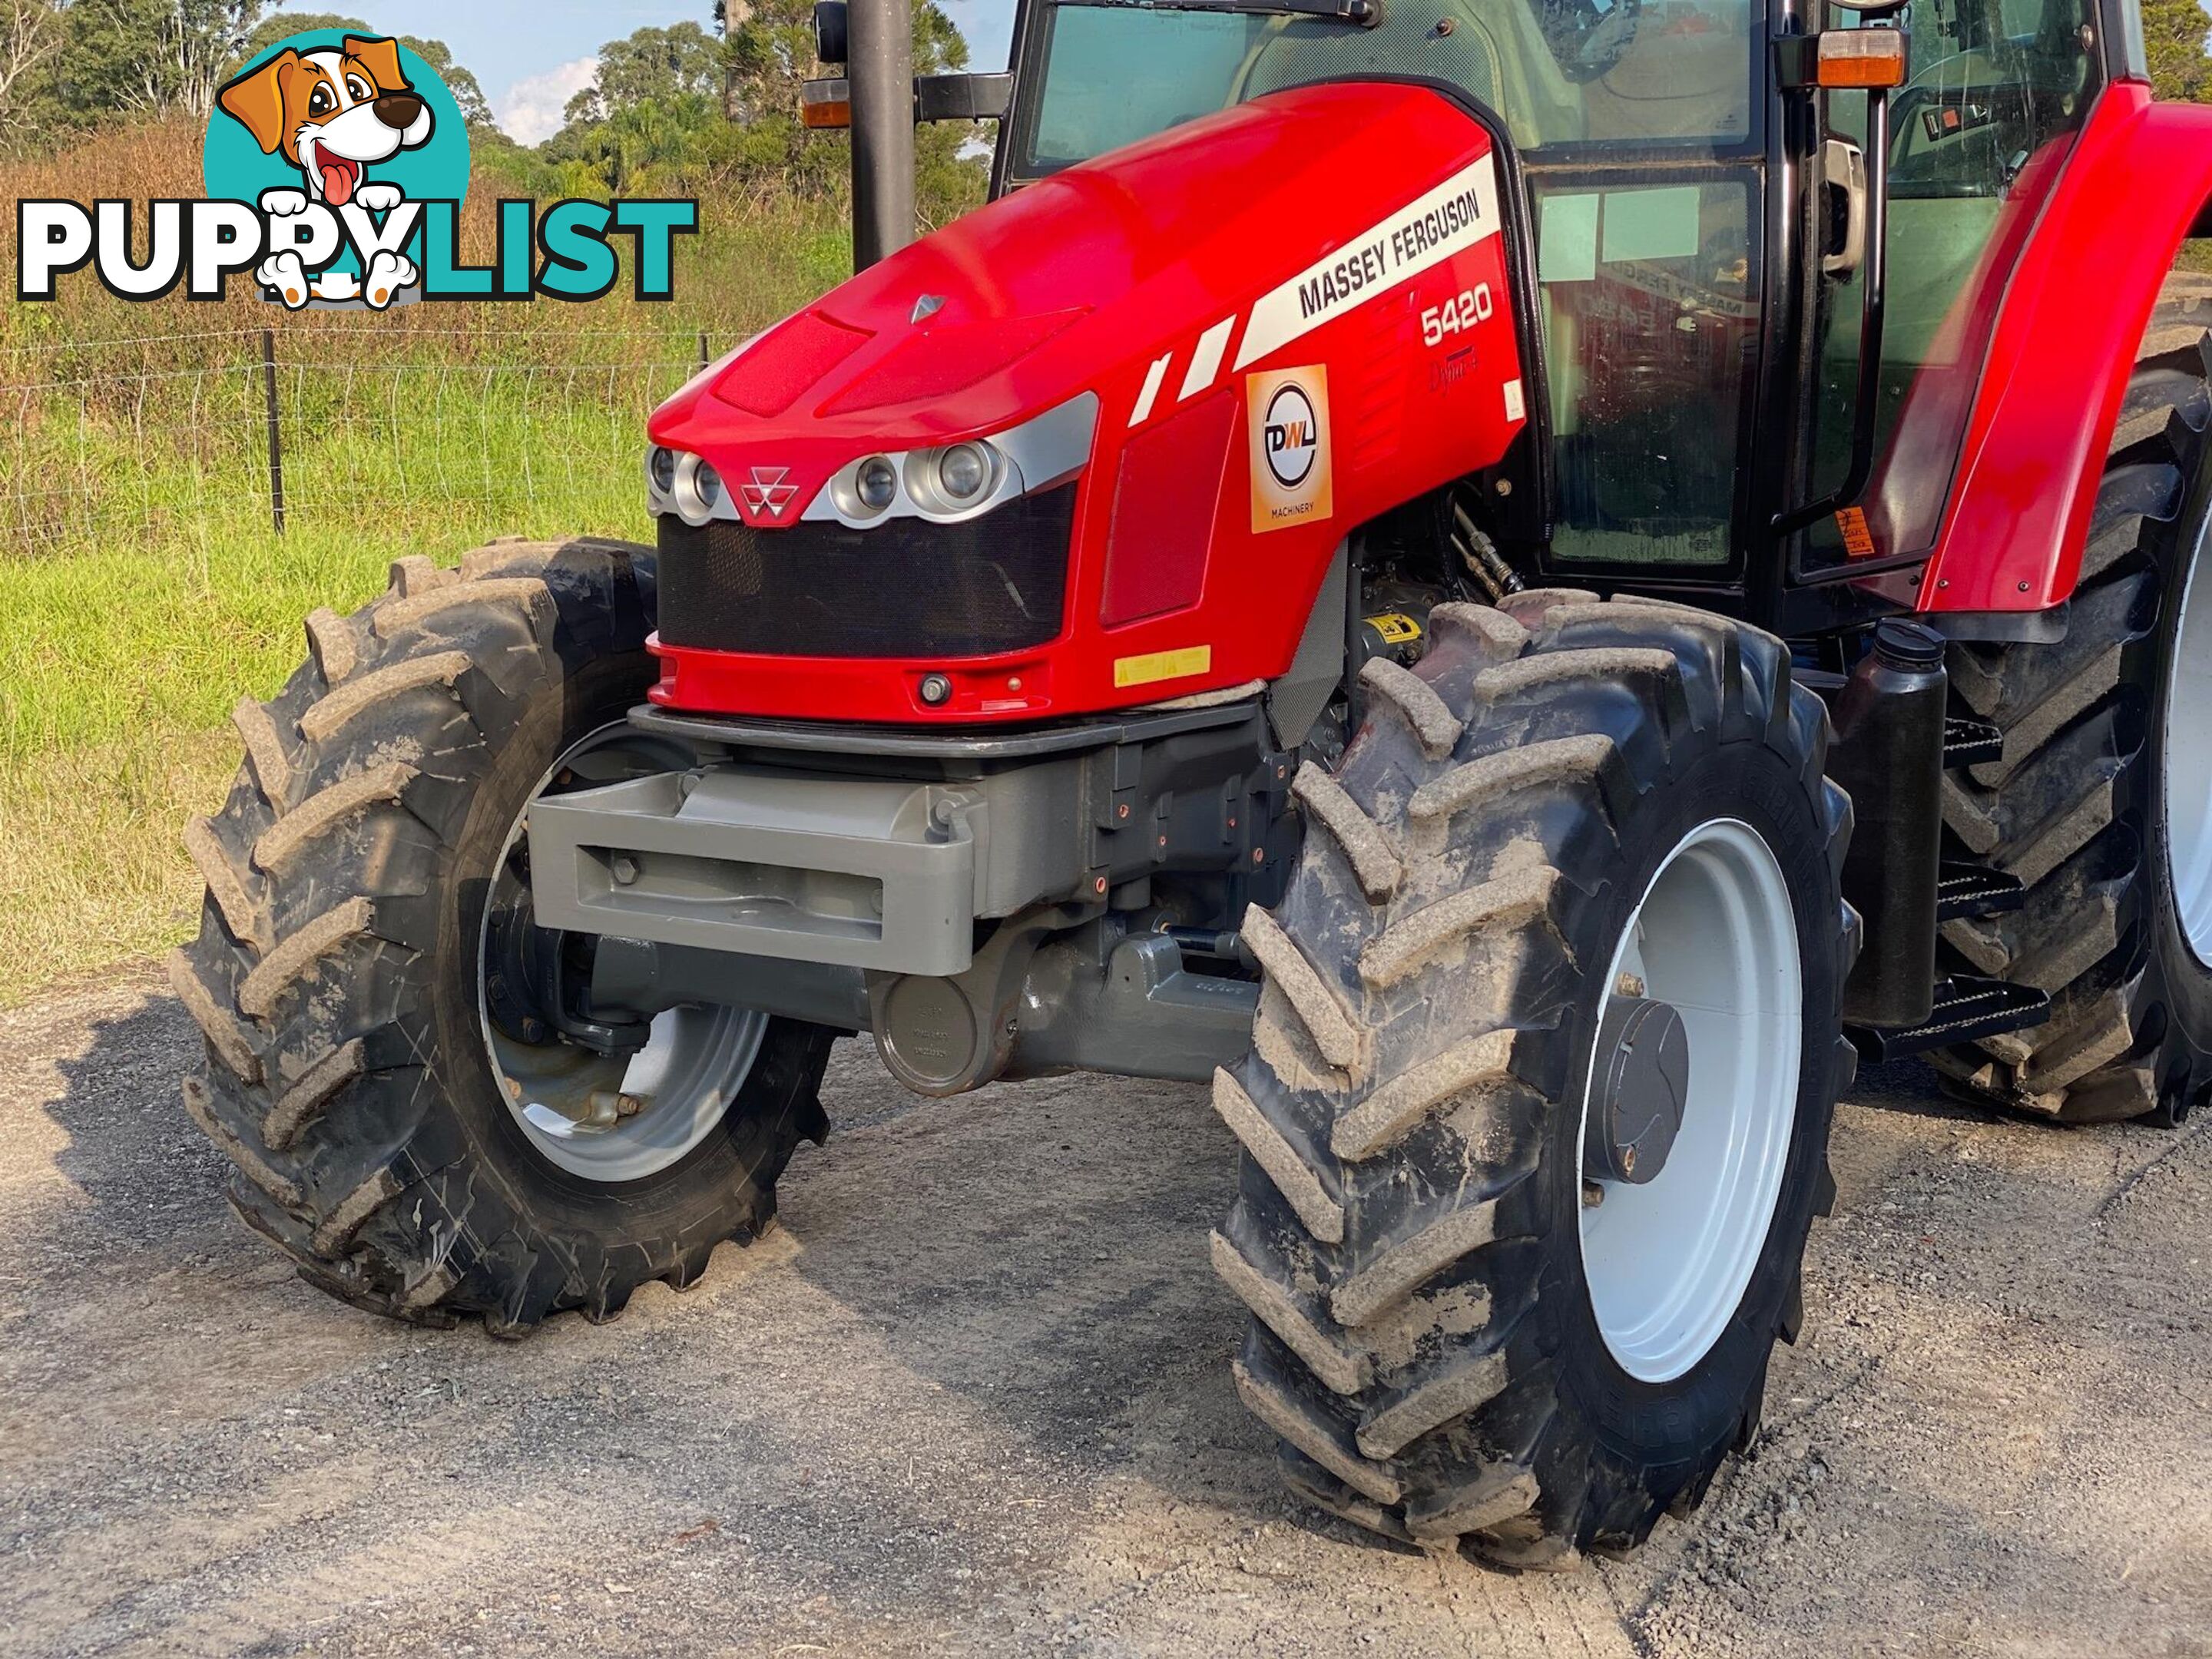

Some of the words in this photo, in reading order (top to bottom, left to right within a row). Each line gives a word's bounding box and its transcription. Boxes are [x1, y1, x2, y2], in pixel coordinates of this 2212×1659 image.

[1298, 239, 1386, 320] MASSEY
[1391, 188, 1480, 267] FERGUSON
[1421, 281, 1493, 347] 5420
[1264, 420, 1316, 452] DWL
[1271, 501, 1315, 519] MACHINERY
